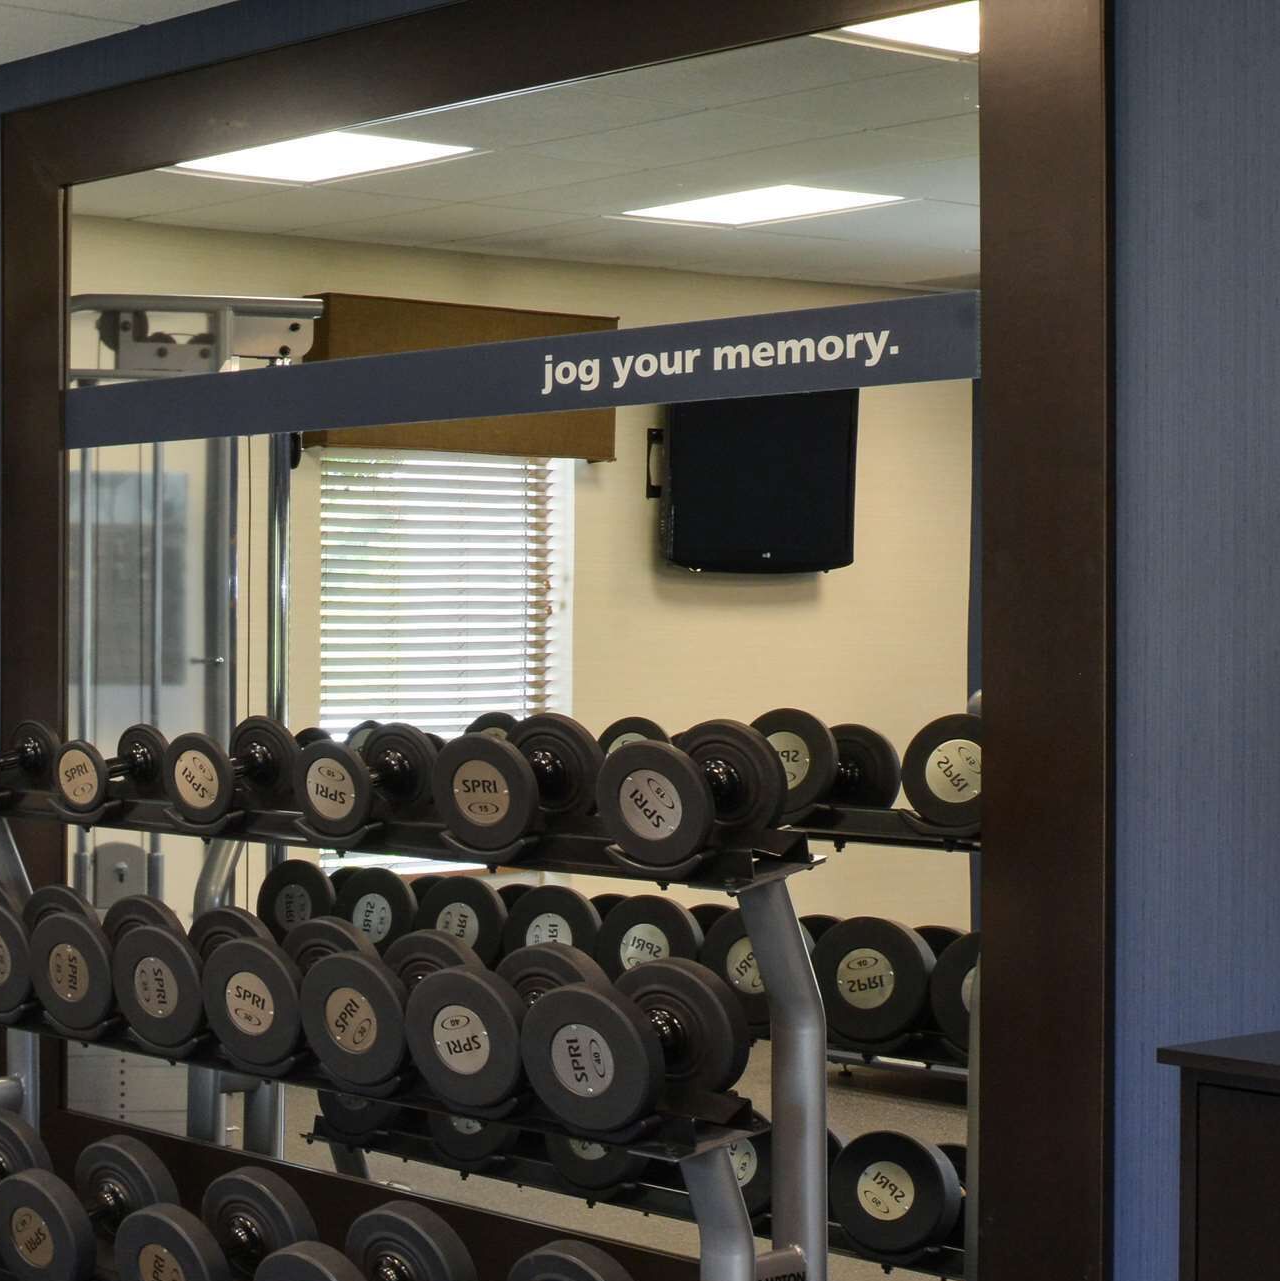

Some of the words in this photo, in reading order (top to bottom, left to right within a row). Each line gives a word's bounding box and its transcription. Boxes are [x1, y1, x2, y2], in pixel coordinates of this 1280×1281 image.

[542, 354, 599, 395] jog
[611, 347, 701, 388] your
[713, 330, 899, 371] memory.
[64, 763, 88, 782] SPRI
[182, 767, 208, 798] SPRI
[315, 783, 346, 804] SPRI
[462, 779, 498, 793] SPRI
[656, 787, 666, 799] 15
[478, 805, 489, 813] 15
[629, 789, 665, 828] SPRI
[68, 956, 78, 991] SPRI
[152, 968, 167, 1005] SPRI
[234, 985, 265, 1010] SPRI
[335, 998, 360, 1033] SPRI
[446, 1035, 482, 1055] SPRI
[566, 1038, 588, 1084] SPRI
[594, 1052, 602, 1065] 40
[25, 1227, 47, 1254] SPRI
